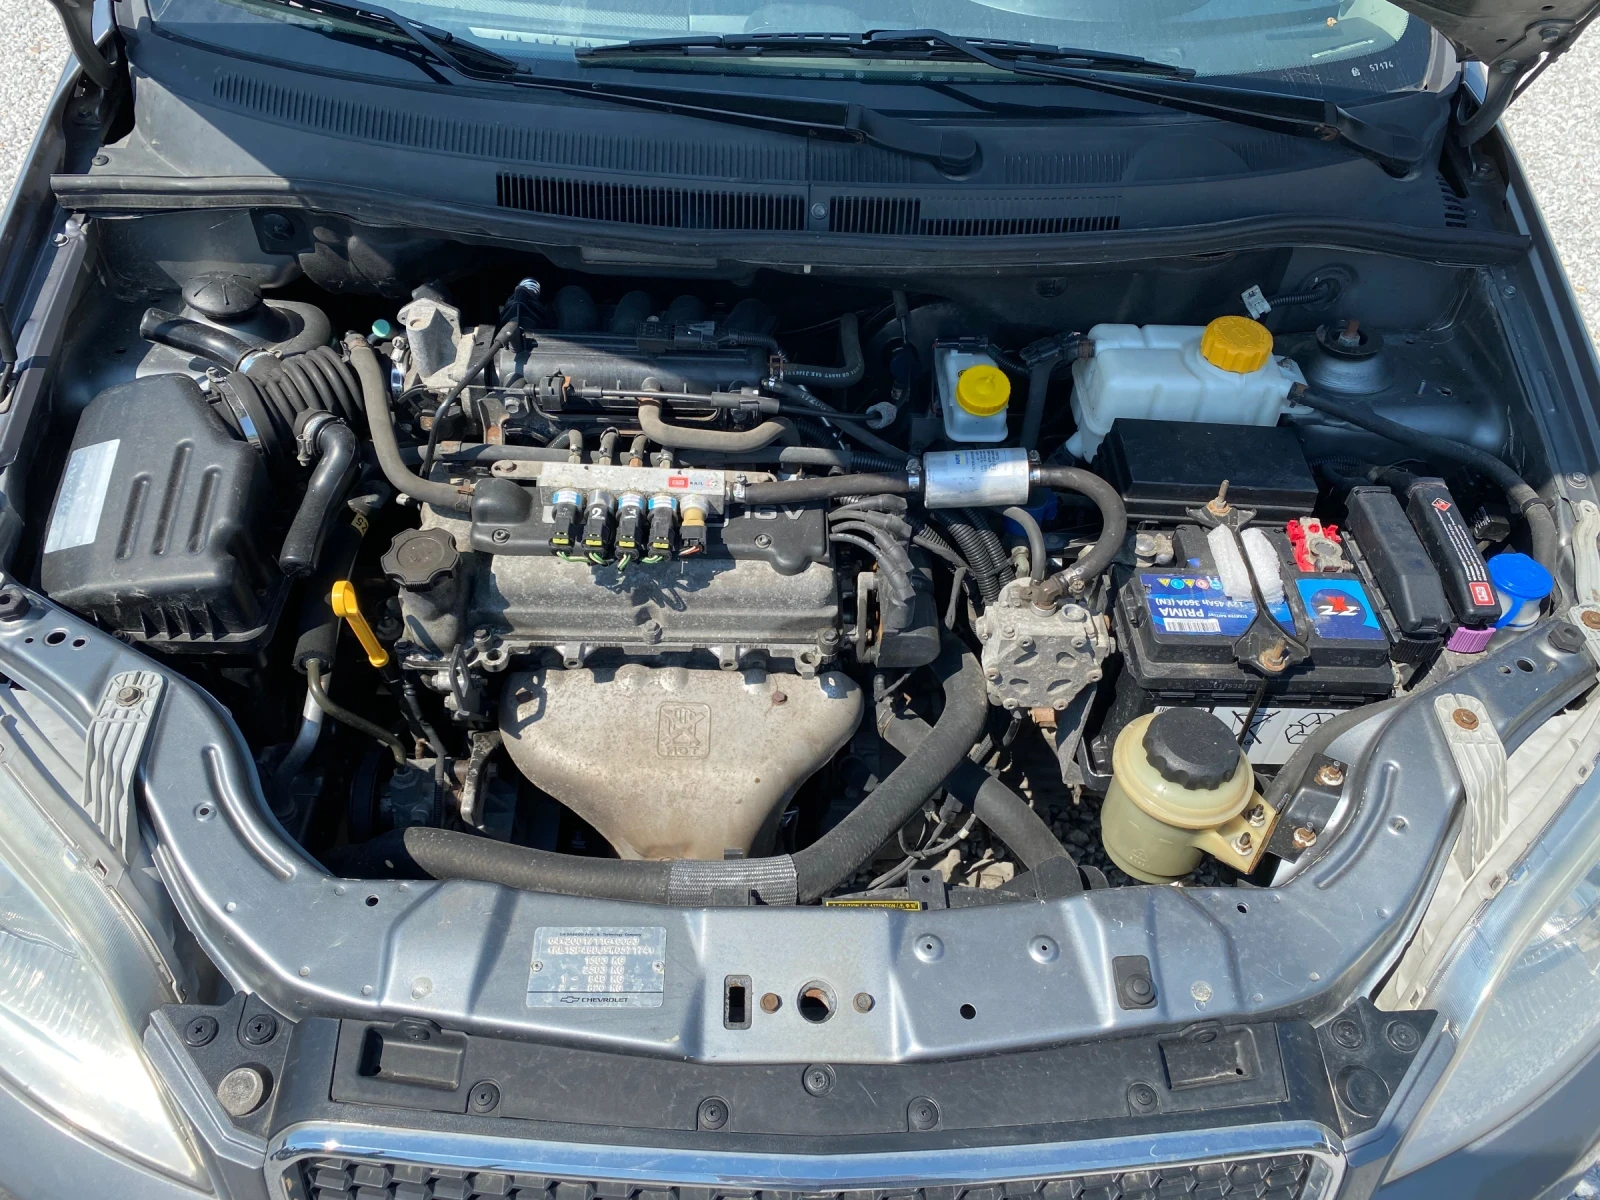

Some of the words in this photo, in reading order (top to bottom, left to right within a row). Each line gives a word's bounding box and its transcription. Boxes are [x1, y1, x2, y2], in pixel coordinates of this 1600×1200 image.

[1156, 597, 1175, 606] (EN)
[1176, 599, 1200, 607] 360A
[1202, 599, 1224, 608] 45Ah
[1158, 607, 1205, 618] PRIMA
[611, 956, 626, 965] KG
[610, 966, 625, 975] KG
[610, 975, 624, 984] KG
[609, 984, 624, 992] KG
